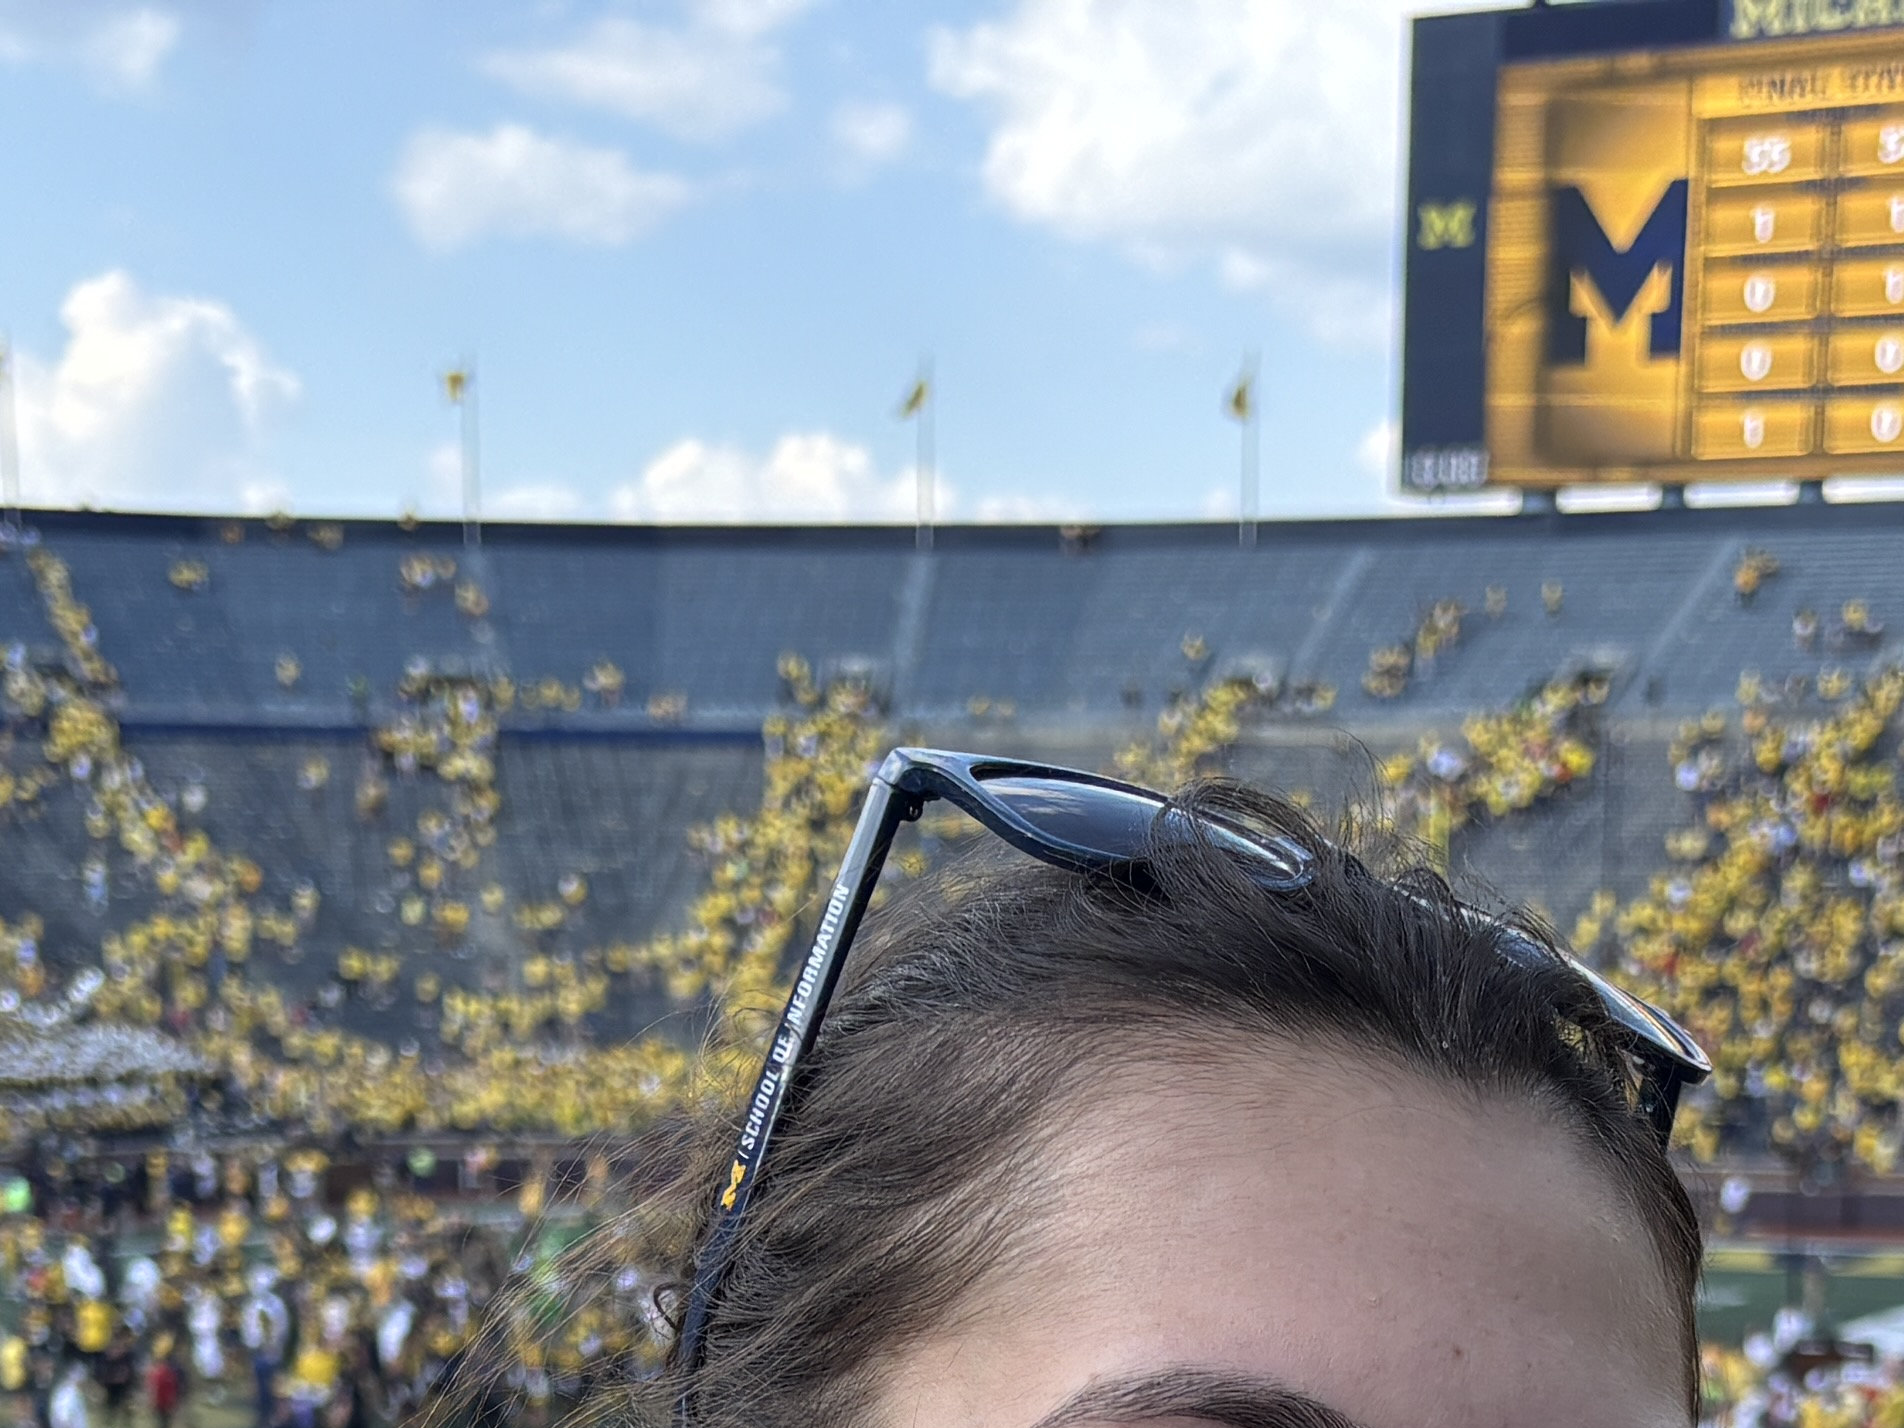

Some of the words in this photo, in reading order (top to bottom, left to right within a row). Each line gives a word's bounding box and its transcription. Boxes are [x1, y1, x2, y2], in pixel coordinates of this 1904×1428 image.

[1544, 178, 1689, 366] M
[721, 1159, 747, 1212] M
[741, 1068, 780, 1152] SCHOOL
